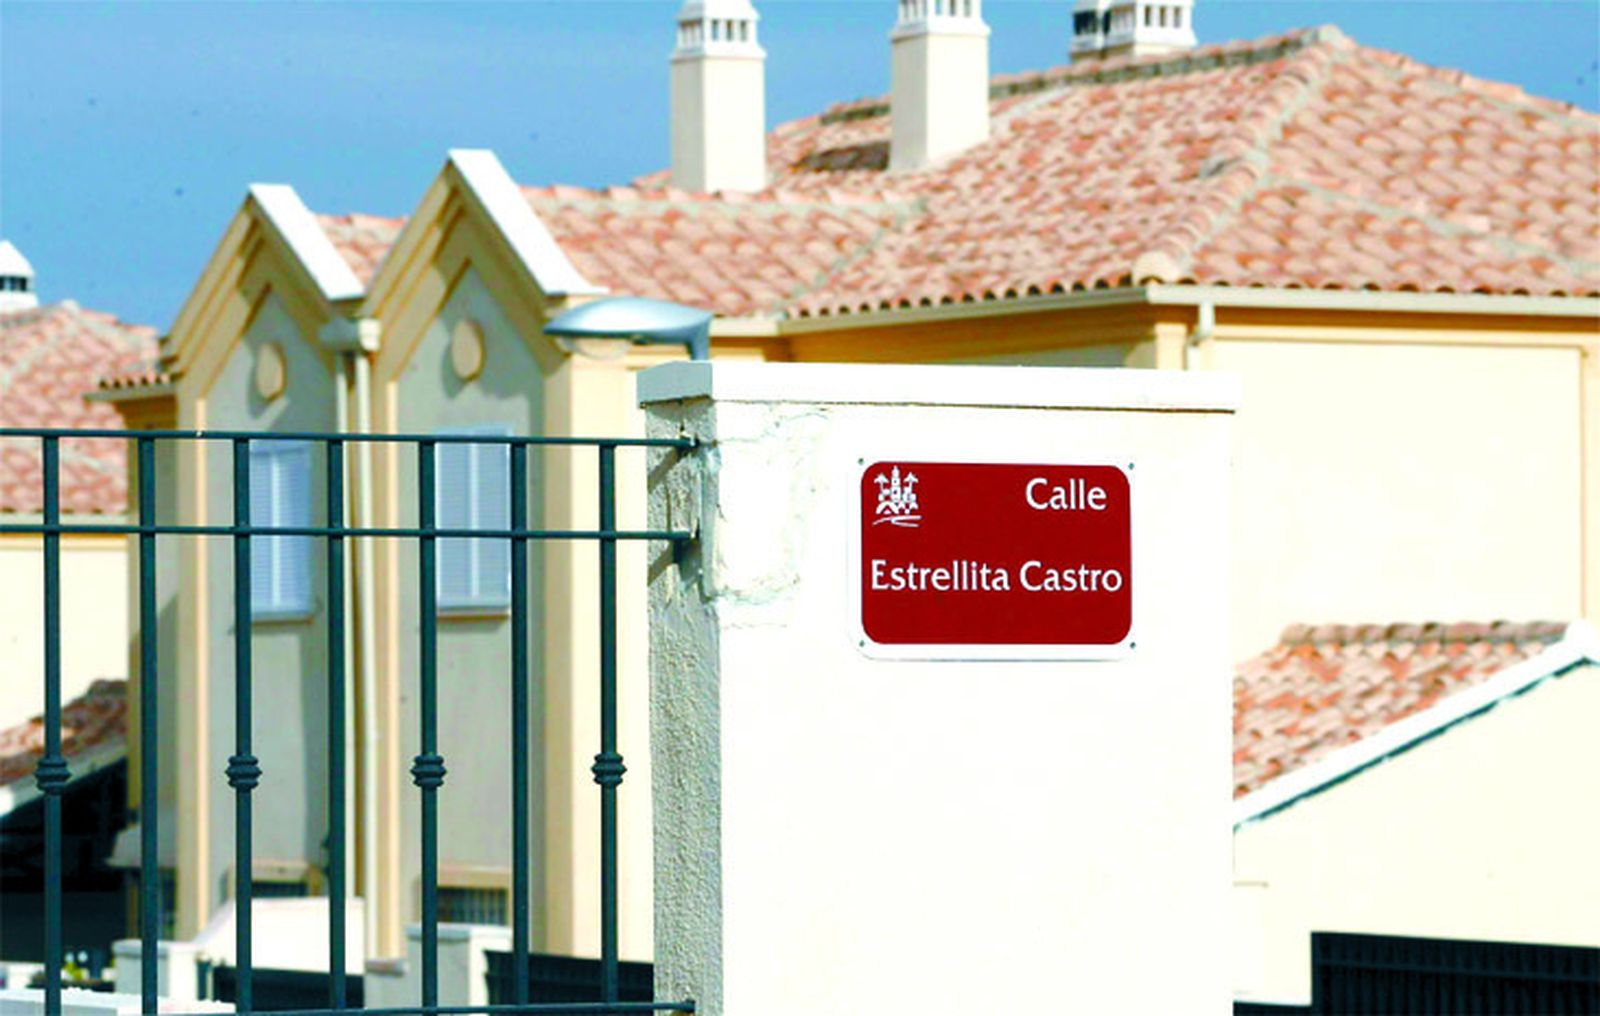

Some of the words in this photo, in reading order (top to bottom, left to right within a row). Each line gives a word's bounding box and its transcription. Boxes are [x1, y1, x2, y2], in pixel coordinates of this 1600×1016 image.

[1025, 477, 1107, 510] Calle
[871, 559, 1011, 591] Estrellita
[1019, 560, 1123, 592] Castro
